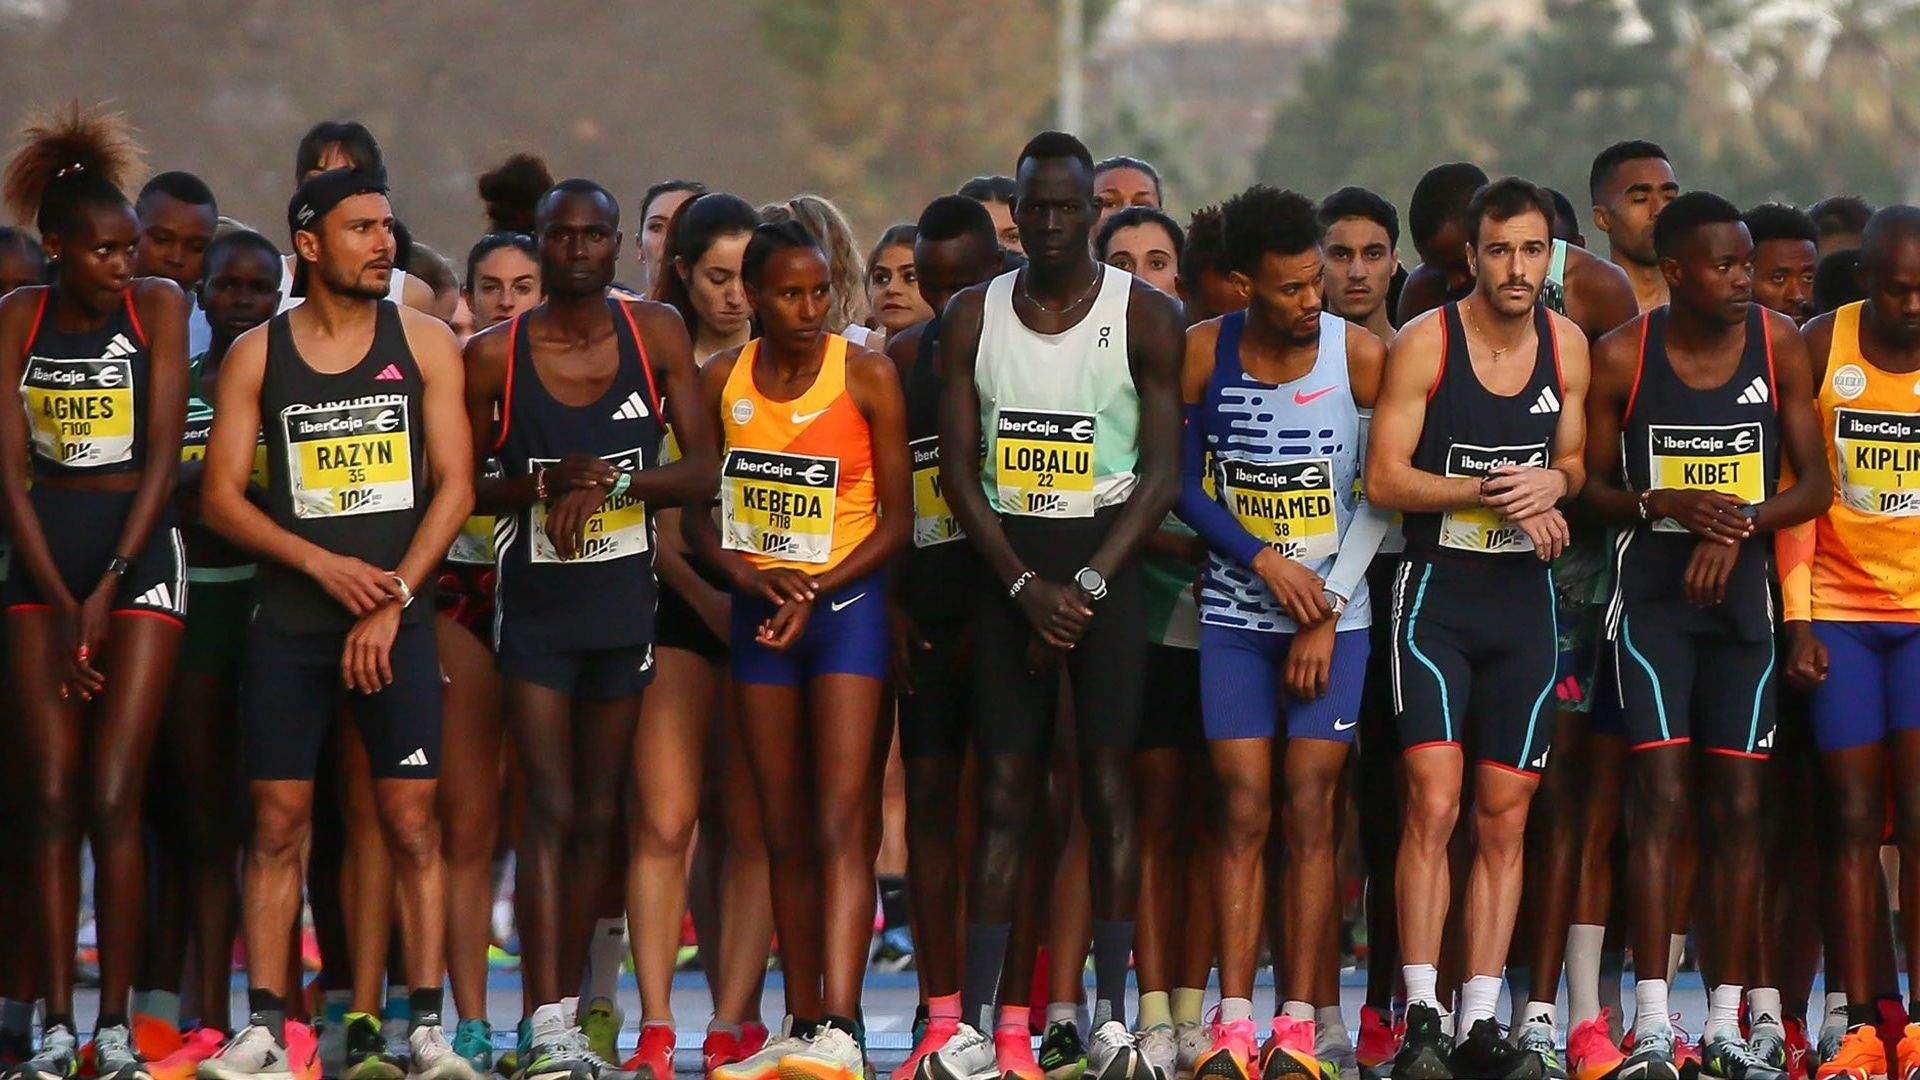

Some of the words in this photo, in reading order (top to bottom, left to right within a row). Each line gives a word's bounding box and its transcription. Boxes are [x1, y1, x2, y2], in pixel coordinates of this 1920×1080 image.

[33, 367, 87, 386] iberCaja
[43, 396, 114, 420] AGNES
[61, 422, 92, 436] F100
[300, 417, 364, 434] iberCaja
[999, 417, 1059, 436] iberCaja
[1850, 420, 1911, 437] iberCaja
[1663, 436, 1724, 452] iberCaja
[316, 440, 393, 470] RAZYN
[1004, 447, 1089, 475] LOBALU
[348, 468, 366, 483] 35
[736, 458, 793, 478] iberCaja
[1684, 462, 1740, 485] KIBET
[1037, 473, 1054, 488] 22
[1236, 468, 1287, 488] iberCaja
[1896, 473, 1902, 488] 1
[338, 488, 374, 512] 10K
[743, 486, 822, 519] KEBEDA
[1026, 493, 1060, 513] 10K
[1235, 494, 1331, 520] MAHAMED
[1879, 493, 1914, 512] 10K
[589, 518, 604, 532] 21
[769, 513, 791, 530] F118
[1273, 522, 1290, 537] 38
[762, 533, 791, 553] 10K
